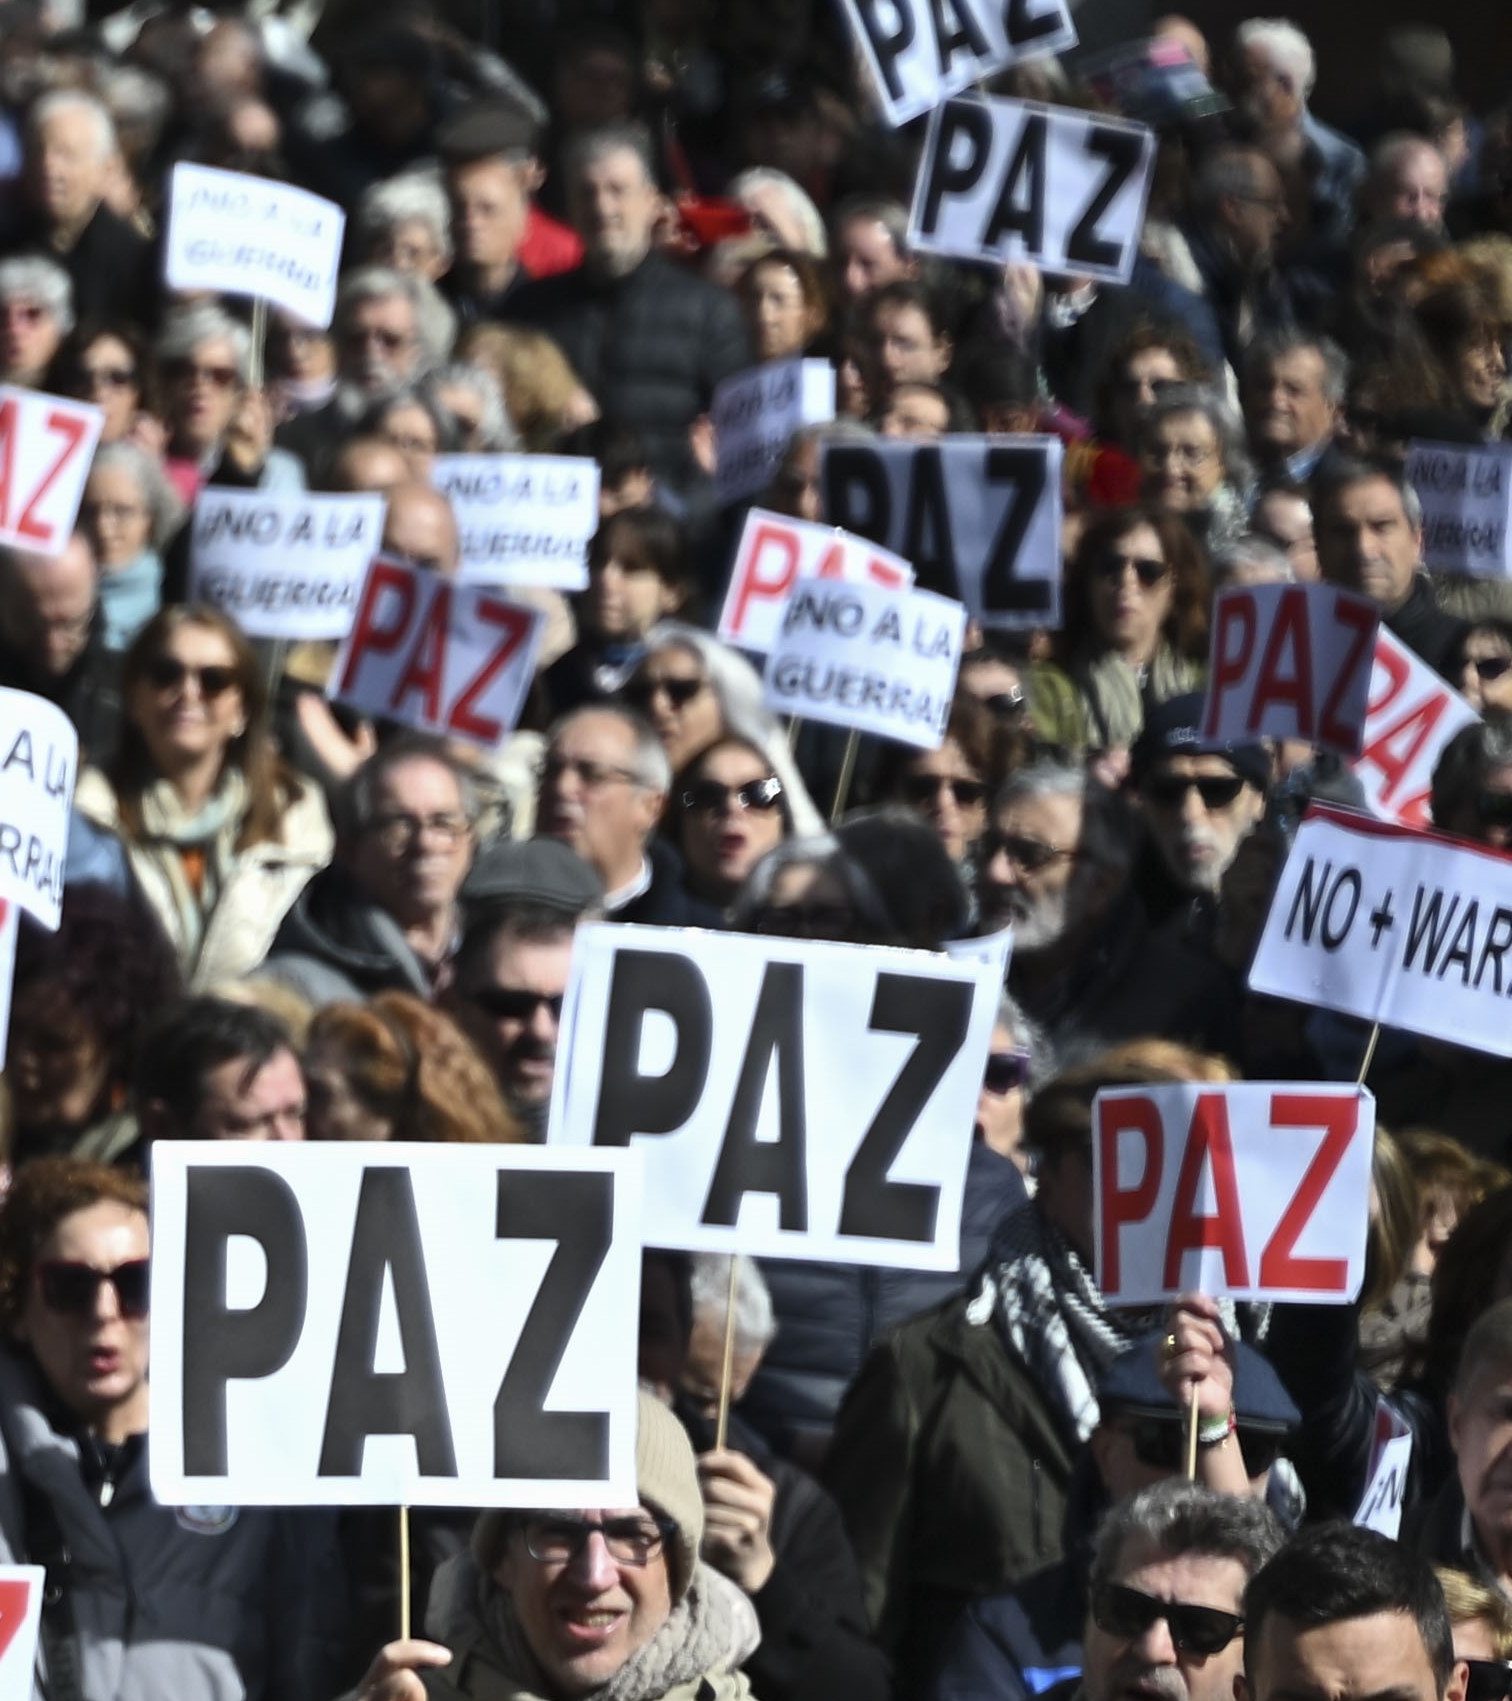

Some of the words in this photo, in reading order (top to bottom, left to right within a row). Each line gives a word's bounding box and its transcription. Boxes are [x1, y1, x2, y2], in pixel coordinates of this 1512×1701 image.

[921, 104, 1147, 267] PAZ
[289, 507, 313, 543] A
[324, 504, 364, 544] LA
[341, 560, 533, 742] PAZ
[871, 605, 902, 645] A
[912, 614, 952, 659] LA
[1204, 587, 1380, 756] PAZ
[2, 729, 35, 781] A
[1284, 856, 1363, 953] NO
[1370, 887, 1394, 950] +
[593, 949, 975, 1243] PAZ
[1099, 1093, 1359, 1294] PAZ
[183, 1166, 615, 1481] PAZ
